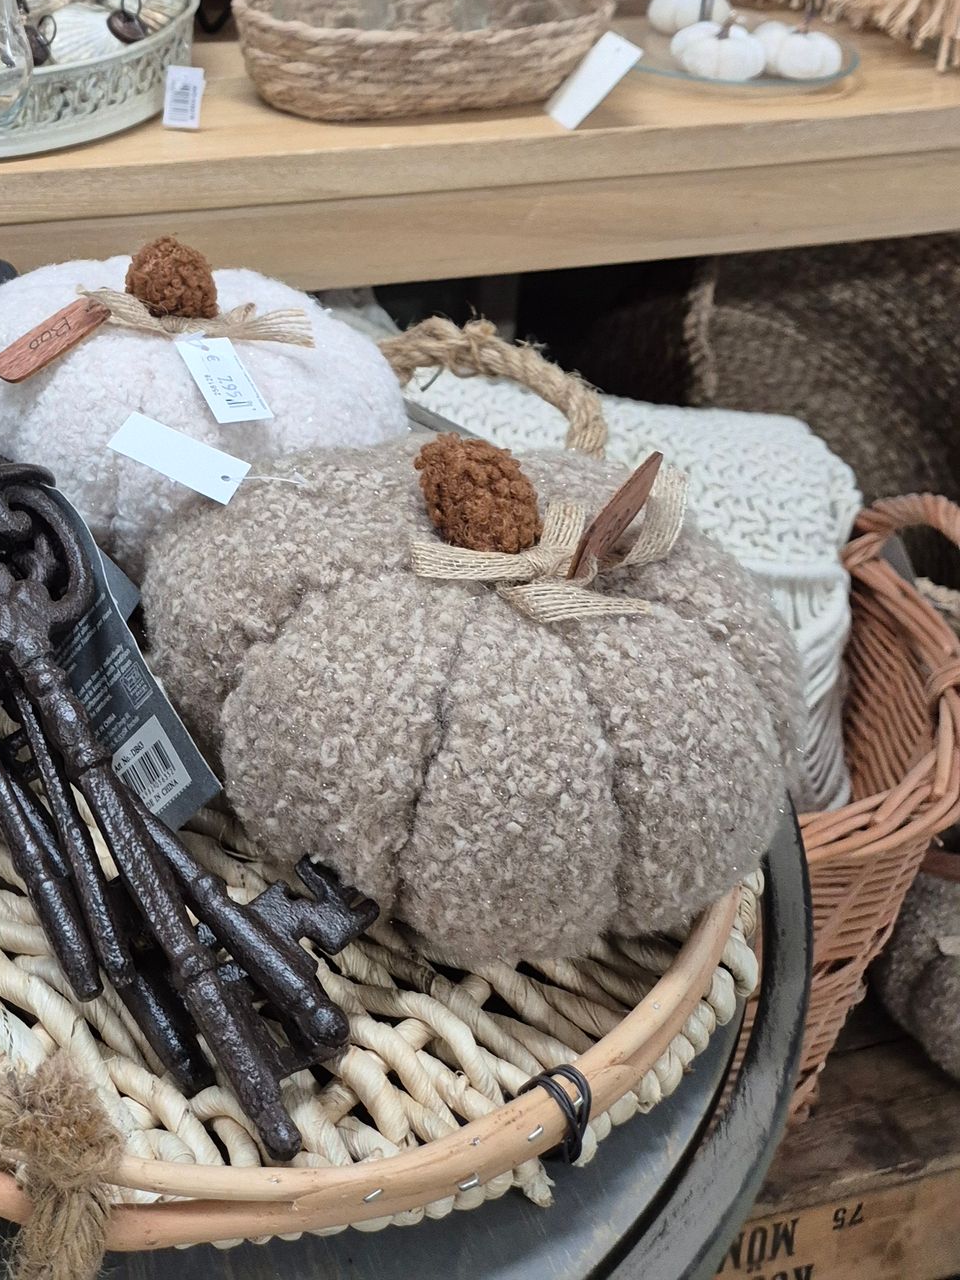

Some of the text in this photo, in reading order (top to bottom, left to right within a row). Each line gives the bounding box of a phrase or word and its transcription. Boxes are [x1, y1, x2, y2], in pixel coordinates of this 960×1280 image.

[217, 375, 242, 398] 7.95
[154, 792, 162, 803] IN
[161, 779, 179, 796] CHINA
[832, 1202, 864, 1231] 75
[716, 1217, 800, 1274] MÜN
